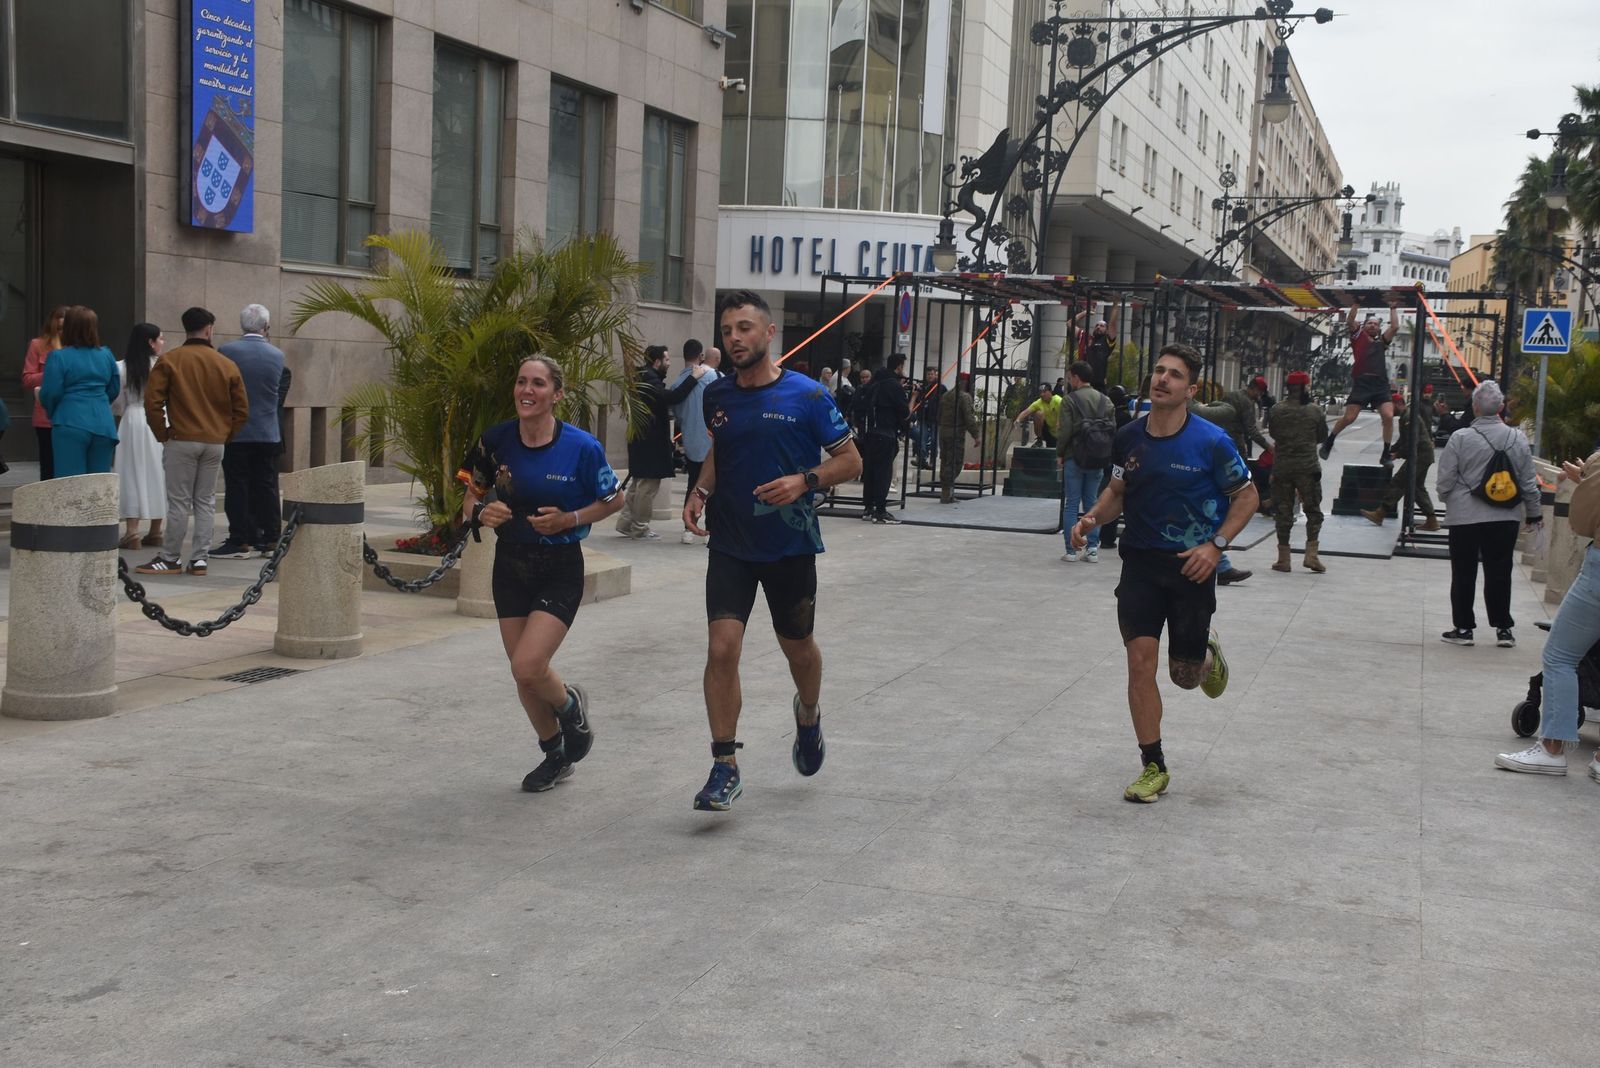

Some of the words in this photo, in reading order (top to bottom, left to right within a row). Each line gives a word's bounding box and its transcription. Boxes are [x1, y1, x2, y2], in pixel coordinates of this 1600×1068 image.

[200, 9, 221, 22] Cinco
[196, 28, 244, 48] garantizando
[245, 39, 253, 48] el
[205, 46, 232, 58] servicio
[233, 55, 239, 67] y
[240, 53, 248, 63] la
[204, 62, 239, 77] movilidad
[240, 69, 249, 79] de
[199, 77, 226, 90] nuestra
[750, 235, 841, 276] HOTEL
[762, 412, 785, 420] GREG
[786, 415, 797, 423] 54
